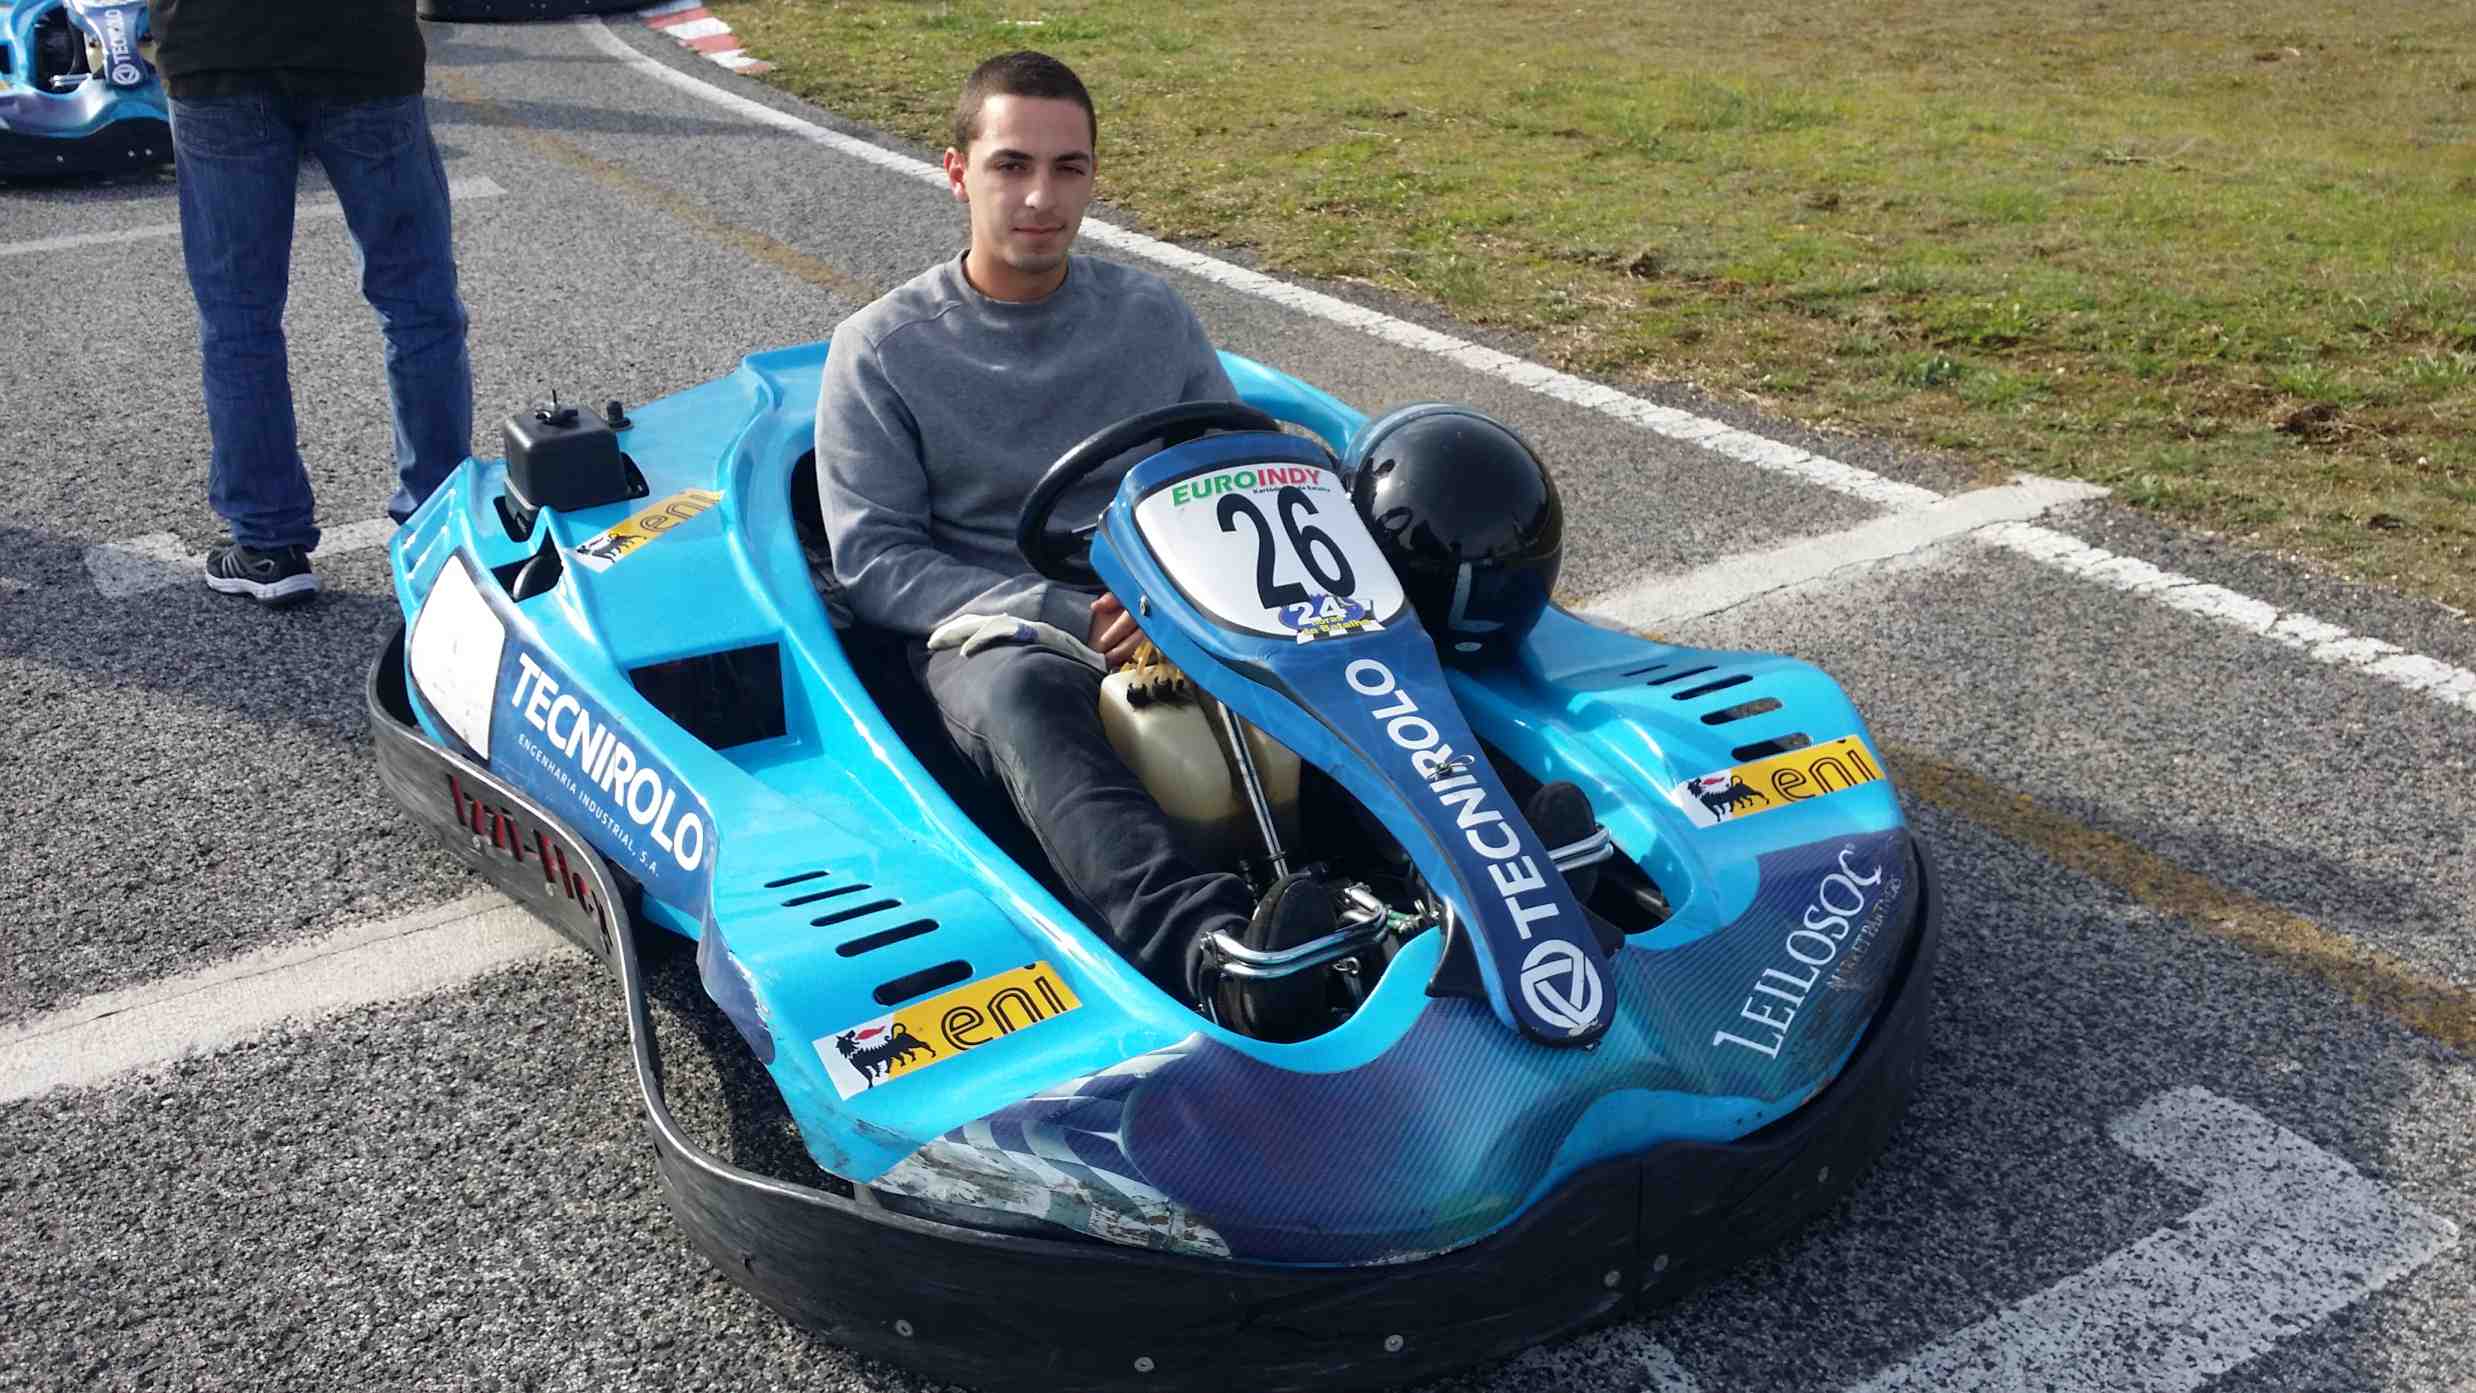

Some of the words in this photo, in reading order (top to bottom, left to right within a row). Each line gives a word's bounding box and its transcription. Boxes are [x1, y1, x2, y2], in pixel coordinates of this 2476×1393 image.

[1171, 467, 1321, 507] EUROINDY
[1216, 485, 1357, 610] 26
[1288, 596, 1347, 626] 24
[511, 652, 704, 872] TECNIROLO
[517, 733, 577, 795] ENGENHARIA
[578, 789, 637, 857] INDUSTRIAL,
[1345, 658, 1560, 940] TECNIROLO
[1770, 745, 1877, 803] eni
[940, 970, 1068, 1051] eni
